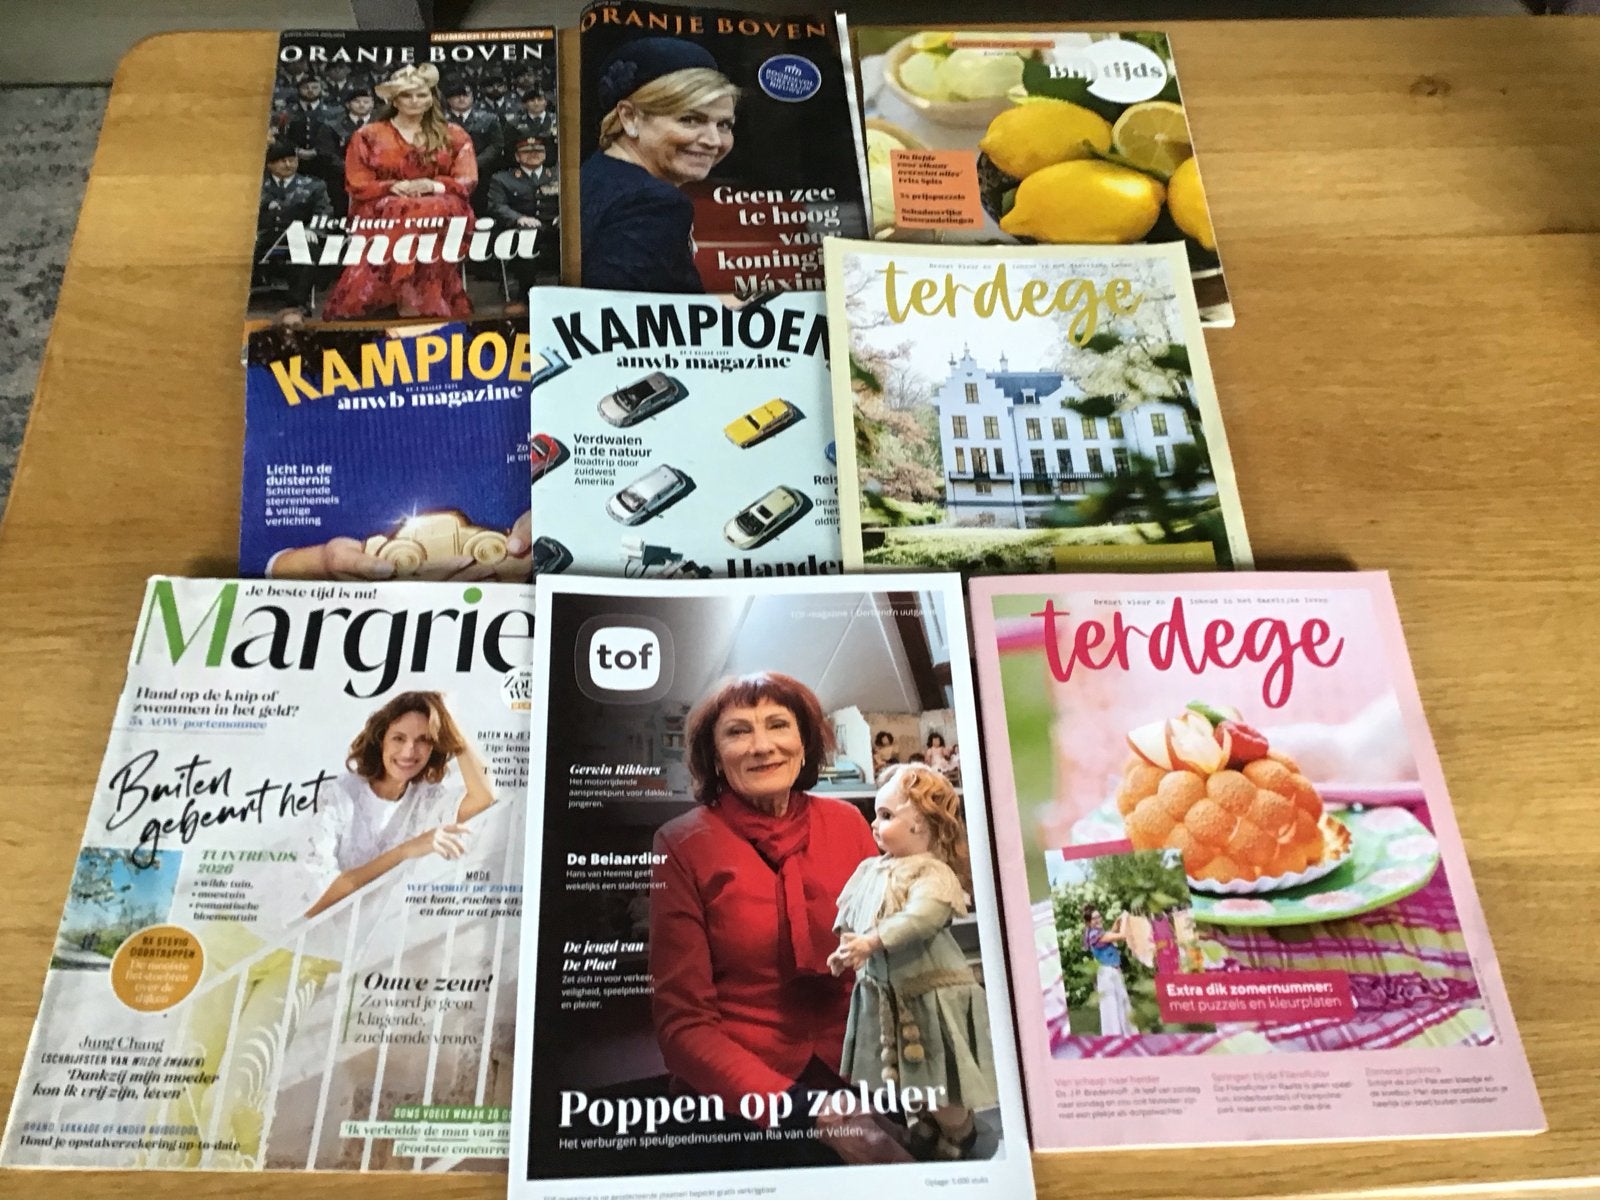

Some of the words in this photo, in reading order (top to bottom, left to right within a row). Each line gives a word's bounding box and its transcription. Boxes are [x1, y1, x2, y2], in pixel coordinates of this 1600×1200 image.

[581, 7, 704, 35] ORANJE
[718, 18, 826, 39] BOVEN
[280, 45, 415, 67] ORANJE
[430, 43, 544, 63] BOVEN
[713, 186, 783, 205] Geen
[790, 187, 836, 203] zee
[310, 215, 347, 229] Het
[346, 216, 399, 233] jaar
[405, 217, 444, 228] van
[739, 208, 767, 226] te
[772, 205, 840, 228] hoog
[259, 216, 540, 266] Amalia
[779, 231, 841, 246] voo
[876, 260, 1146, 347] terdege
[617, 354, 679, 370] anwb
[686, 353, 791, 373] magazine
[338, 391, 405, 410] anwb
[411, 384, 523, 408] magazine
[573, 433, 643, 446] Verdwalen
[574, 445, 586, 456] in
[590, 445, 606, 456] de
[609, 446, 653, 458] natuur
[266, 463, 297, 475] Licht
[301, 463, 313, 475] in
[317, 462, 333, 475] de
[574, 457, 615, 469] Roadtrip
[617, 458, 639, 467] door
[574, 466, 616, 477] zuidwest
[266, 474, 331, 486] duisternis
[574, 477, 615, 487] Amerika
[265, 486, 331, 496] Schitterende
[265, 495, 339, 507] sterrenhemels
[276, 506, 310, 516] veilige
[265, 516, 322, 528] verlichting
[727, 554, 844, 578] Hande
[245, 585, 263, 597] Je
[266, 585, 307, 597] beste
[311, 586, 335, 600] tijd
[339, 587, 351, 599] is
[354, 587, 377, 599] nu!
[136, 580, 536, 699] Margrie
[596, 642, 654, 670] tof
[1031, 596, 1345, 708] terdege
[136, 686, 177, 701] Hand
[180, 689, 199, 703] op
[203, 688, 221, 701] de
[224, 689, 258, 704] knip
[262, 688, 280, 702] of
[132, 703, 210, 716] zwemmen
[214, 703, 228, 716] in
[232, 703, 255, 716] het
[259, 704, 300, 719] geld?
[569, 764, 612, 776] Gerwin
[615, 763, 662, 776] Rikkers
[106, 749, 232, 831] Buiten
[569, 778, 583, 786] Het
[584, 778, 638, 788] motorrijdende
[568, 789, 624, 798] aanspreekpunt
[131, 778, 282, 869] gebeurt
[279, 769, 338, 817] het
[567, 852, 587, 866] De
[590, 851, 668, 866] Beiaardier
[465, 870, 490, 881] MODE
[566, 870, 586, 878] Hans
[603, 869, 633, 878] Heemst
[634, 869, 654, 879] geeft
[565, 882, 600, 892] wekelijks
[436, 906, 464, 917] daar
[563, 941, 581, 954] De
[582, 939, 619, 955] jeugd
[620, 941, 644, 953] van
[562, 958, 581, 972] De
[364, 971, 429, 992] Ouwe
[433, 974, 494, 992] zeur!
[577, 974, 592, 984] zich
[594, 974, 602, 983] in
[603, 975, 621, 983] voor
[1165, 983, 1203, 997] Extra
[1206, 982, 1228, 996] dik
[1230, 982, 1334, 996] zomernummer:
[359, 994, 381, 1008] Zo
[384, 995, 421, 1008] word
[422, 997, 437, 1013] je
[561, 1001, 572, 1009] en
[1169, 1000, 1196, 1012] met
[1199, 998, 1247, 1014] puzzels
[1249, 999, 1267, 1010] en
[1269, 996, 1343, 1011] kleurplaten
[117, 1036, 165, 1052] Chang
[354, 1030, 430, 1045] zuchtende
[110, 1055, 128, 1065] VAN
[129, 1073, 161, 1086] mijn
[164, 1072, 219, 1085] moeder
[32, 1083, 60, 1097] kon
[63, 1083, 79, 1097] ik
[80, 1084, 107, 1101] vrij
[559, 1090, 726, 1136] Poppen
[740, 1090, 793, 1129] op
[807, 1078, 946, 1118] zolder
[364, 1124, 420, 1136] verleidde
[423, 1125, 439, 1136] de
[441, 1128, 469, 1137] man
[473, 1128, 494, 1137] van
[54, 1136, 66, 1149] je
[559, 1137, 578, 1150] Het
[580, 1136, 637, 1151] verburgen
[639, 1131, 742, 1149] speulgoedmuseum
[744, 1131, 763, 1143] van
[766, 1129, 782, 1141] Ria
[784, 1129, 804, 1141] van
[806, 1127, 823, 1140] der
[826, 1126, 864, 1138] Velden
